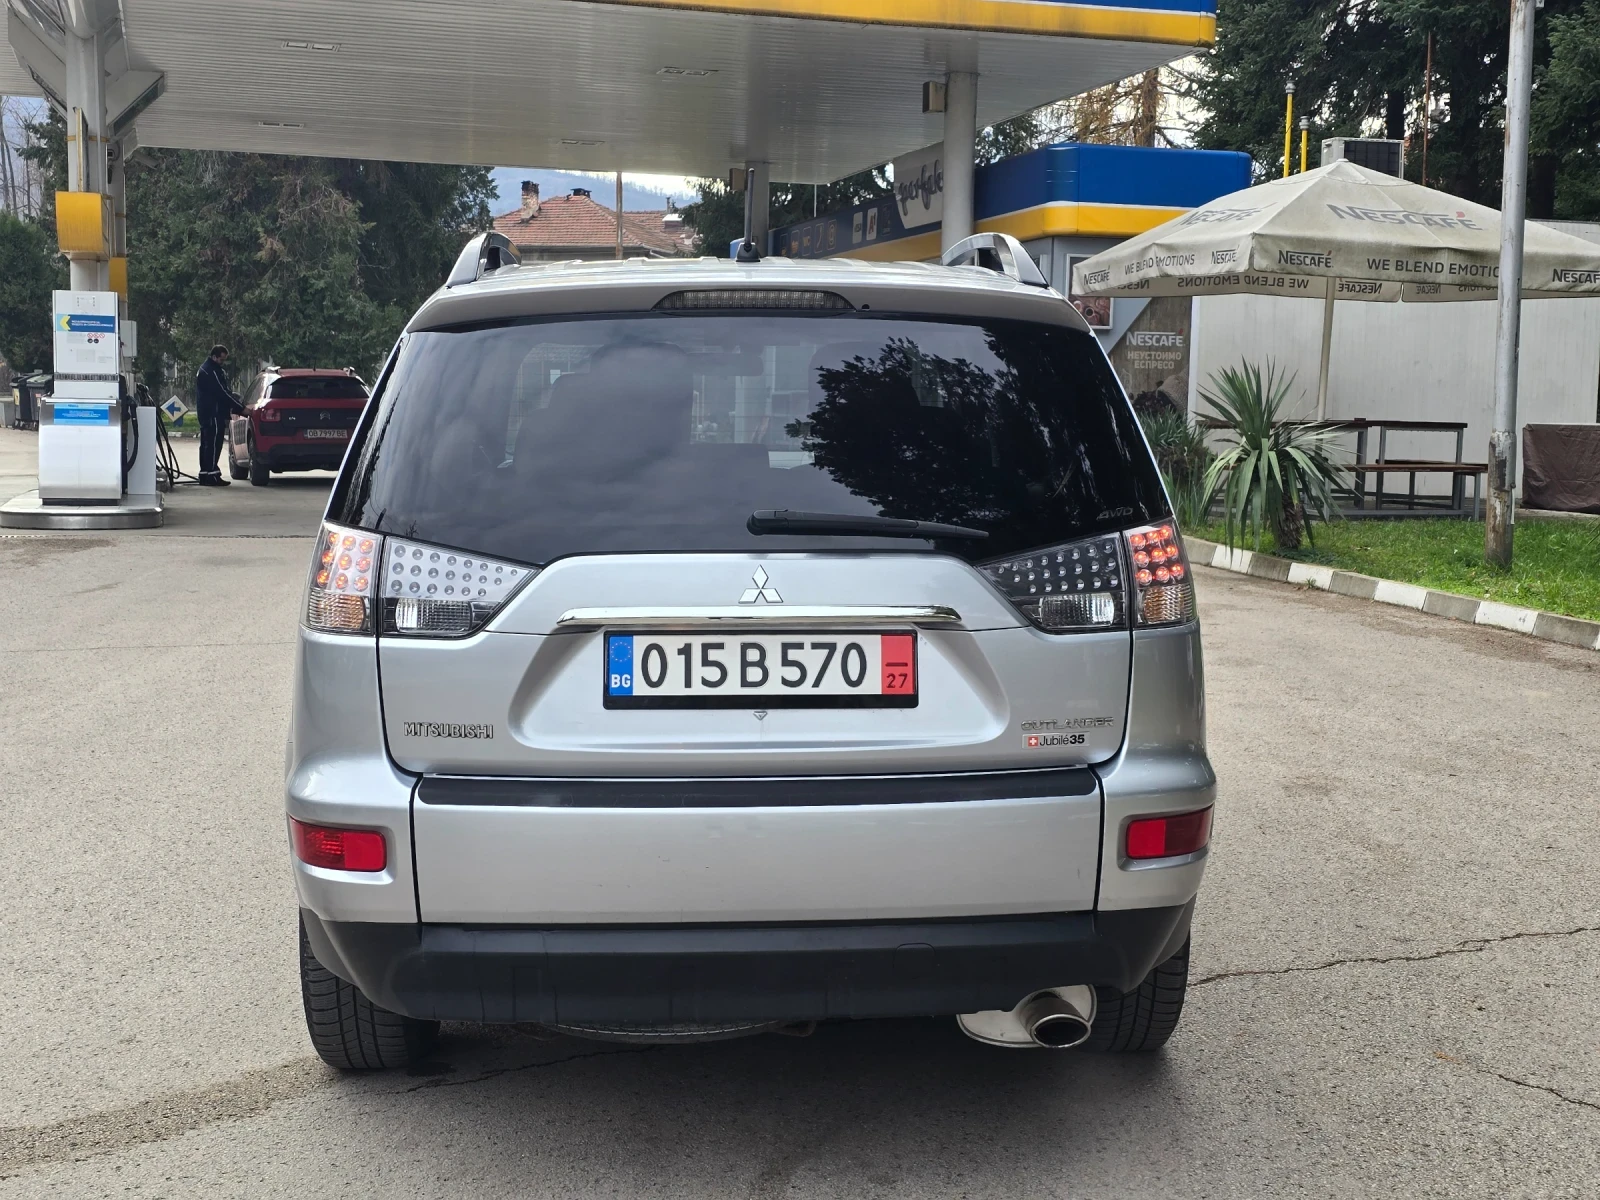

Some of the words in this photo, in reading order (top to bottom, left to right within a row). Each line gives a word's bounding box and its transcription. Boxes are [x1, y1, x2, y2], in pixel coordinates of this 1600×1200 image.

[1326, 203, 1483, 231] NESCAFÉ
[1124, 263, 1135, 276] WE
[1156, 254, 1196, 267] EMOTIONS
[1278, 250, 1333, 268] NESCAFÉ
[1367, 258, 1390, 271] WE
[1395, 260, 1444, 274] BLEND
[1552, 268, 1600, 284] NESCAF
[1126, 328, 1185, 347] NESCAFÉ
[1127, 351, 1182, 361] НЕУСТОИМО
[1134, 361, 1175, 370] ЕСПРЕСО
[611, 674, 631, 689] BG
[886, 674, 908, 689] 27
[403, 722, 494, 739] MITSUBISHI
[1021, 716, 1114, 732] OUTLANDER
